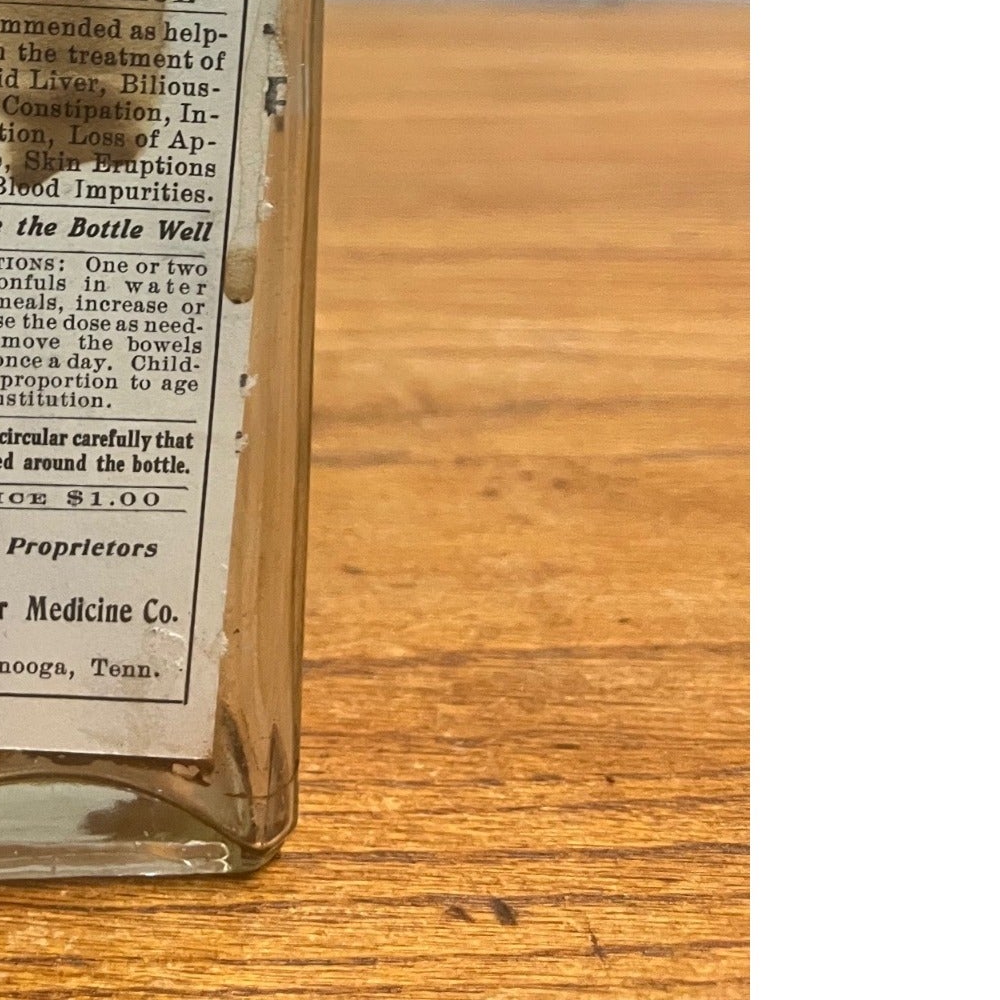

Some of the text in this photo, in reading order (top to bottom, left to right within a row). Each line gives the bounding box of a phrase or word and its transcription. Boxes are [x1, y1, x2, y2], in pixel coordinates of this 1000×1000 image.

[130, 25, 156, 40] as
[161, 21, 228, 48] help-
[18, 42, 57, 63] the
[68, 45, 193, 69] treatment
[200, 51, 226, 71] of
[29, 69, 106, 98] Liver,
[120, 73, 220, 97] Bilious-
[2, 94, 170, 127] Constipation,
[180, 103, 219, 123] In-
[69, 125, 126, 146] Loss
[135, 129, 160, 148] of
[168, 130, 217, 155] Ap-
[24, 151, 82, 172] Skin
[91, 156, 216, 179] Eruptions
[75, 179, 213, 204] Impurities.
[16, 215, 57, 236] the
[67, 217, 143, 239] Bottle
[159, 220, 213, 242] Well
[86, 256, 128, 273] One
[136, 262, 160, 274] or
[168, 259, 207, 276] two
[84, 276, 106, 292] in
[125, 279, 207, 295] water
[76, 294, 168, 313] increase
[181, 302, 205, 315] or
[23, 313, 57, 330] the
[63, 314, 111, 331] dose
[116, 320, 138, 332] as
[144, 318, 203, 334] need-
[1, 336, 60, 349] move
[79, 334, 113, 351] the
[127, 336, 202, 354] bowels
[48, 357, 61, 368] a
[67, 353, 112, 373] day.
[131, 355, 200, 372] Child-
[0, 373, 118, 392] proportion
[130, 374, 151, 390] to
[161, 379, 198, 395] age
[73, 429, 152, 452] carefully
[156, 430, 194, 449] that
[23, 453, 86, 471] around
[97, 454, 125, 472] the
[133, 454, 190, 474] bottle.
[67, 490, 159, 507] $1.00
[6, 537, 158, 561] Proprietors
[25, 595, 132, 623] Medicine
[143, 598, 178, 624] Co.
[91, 658, 160, 678] Tenn.
